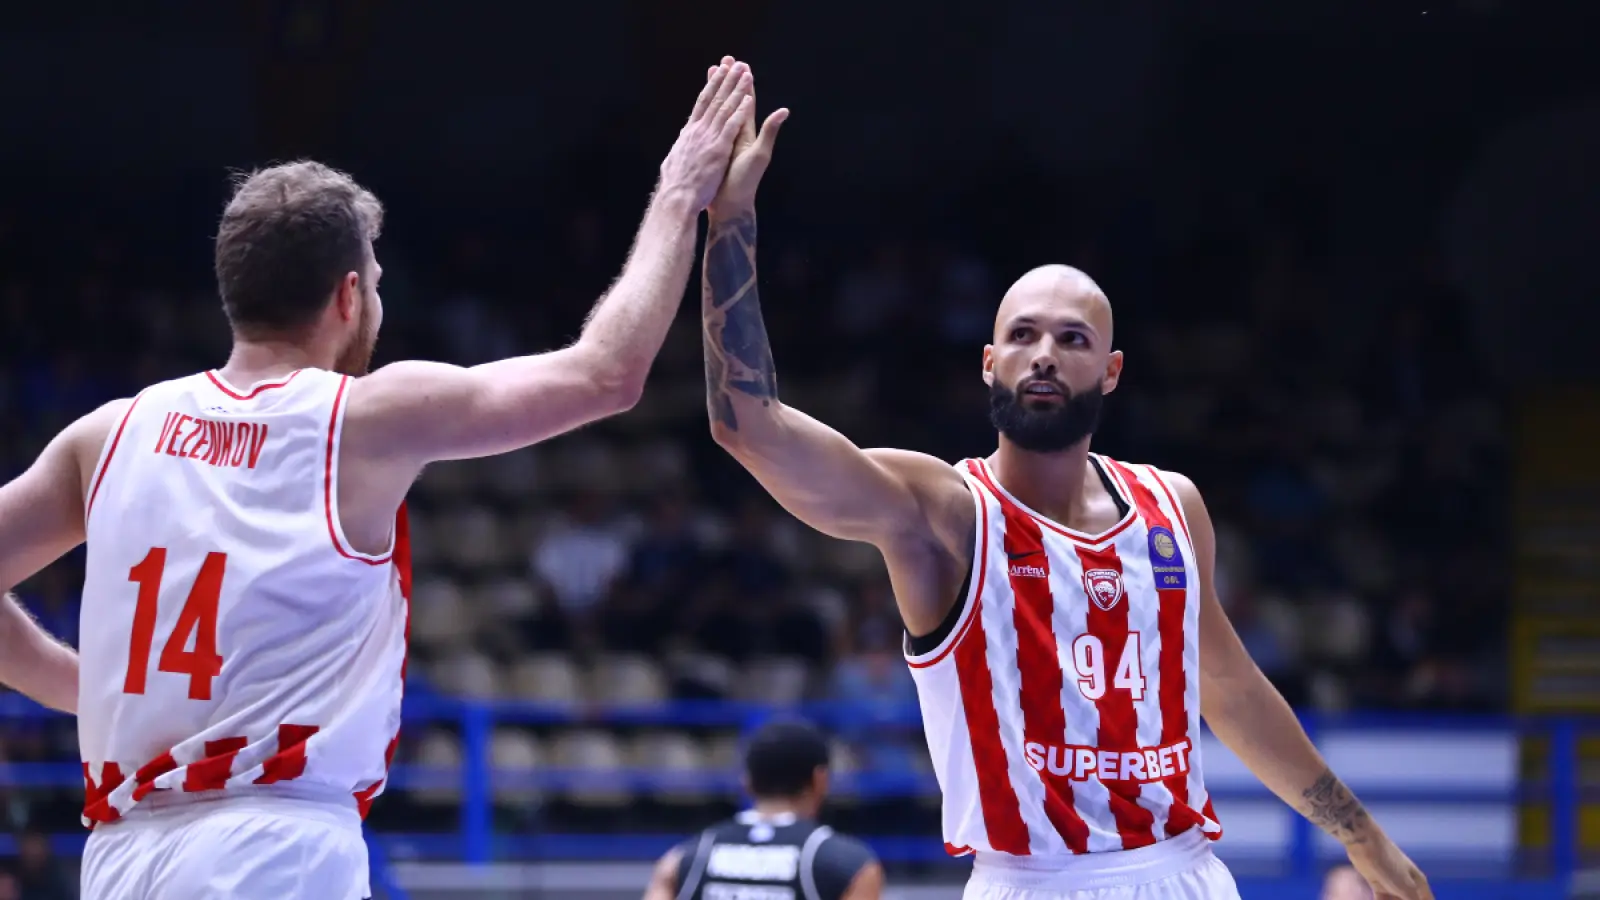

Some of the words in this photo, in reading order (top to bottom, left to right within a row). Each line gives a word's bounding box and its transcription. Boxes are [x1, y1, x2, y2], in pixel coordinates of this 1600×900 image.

[154, 411, 268, 469] VEZENKOV
[123, 547, 228, 701] 14
[1073, 631, 1147, 701] 94
[1024, 740, 1189, 781] SUPERBET
